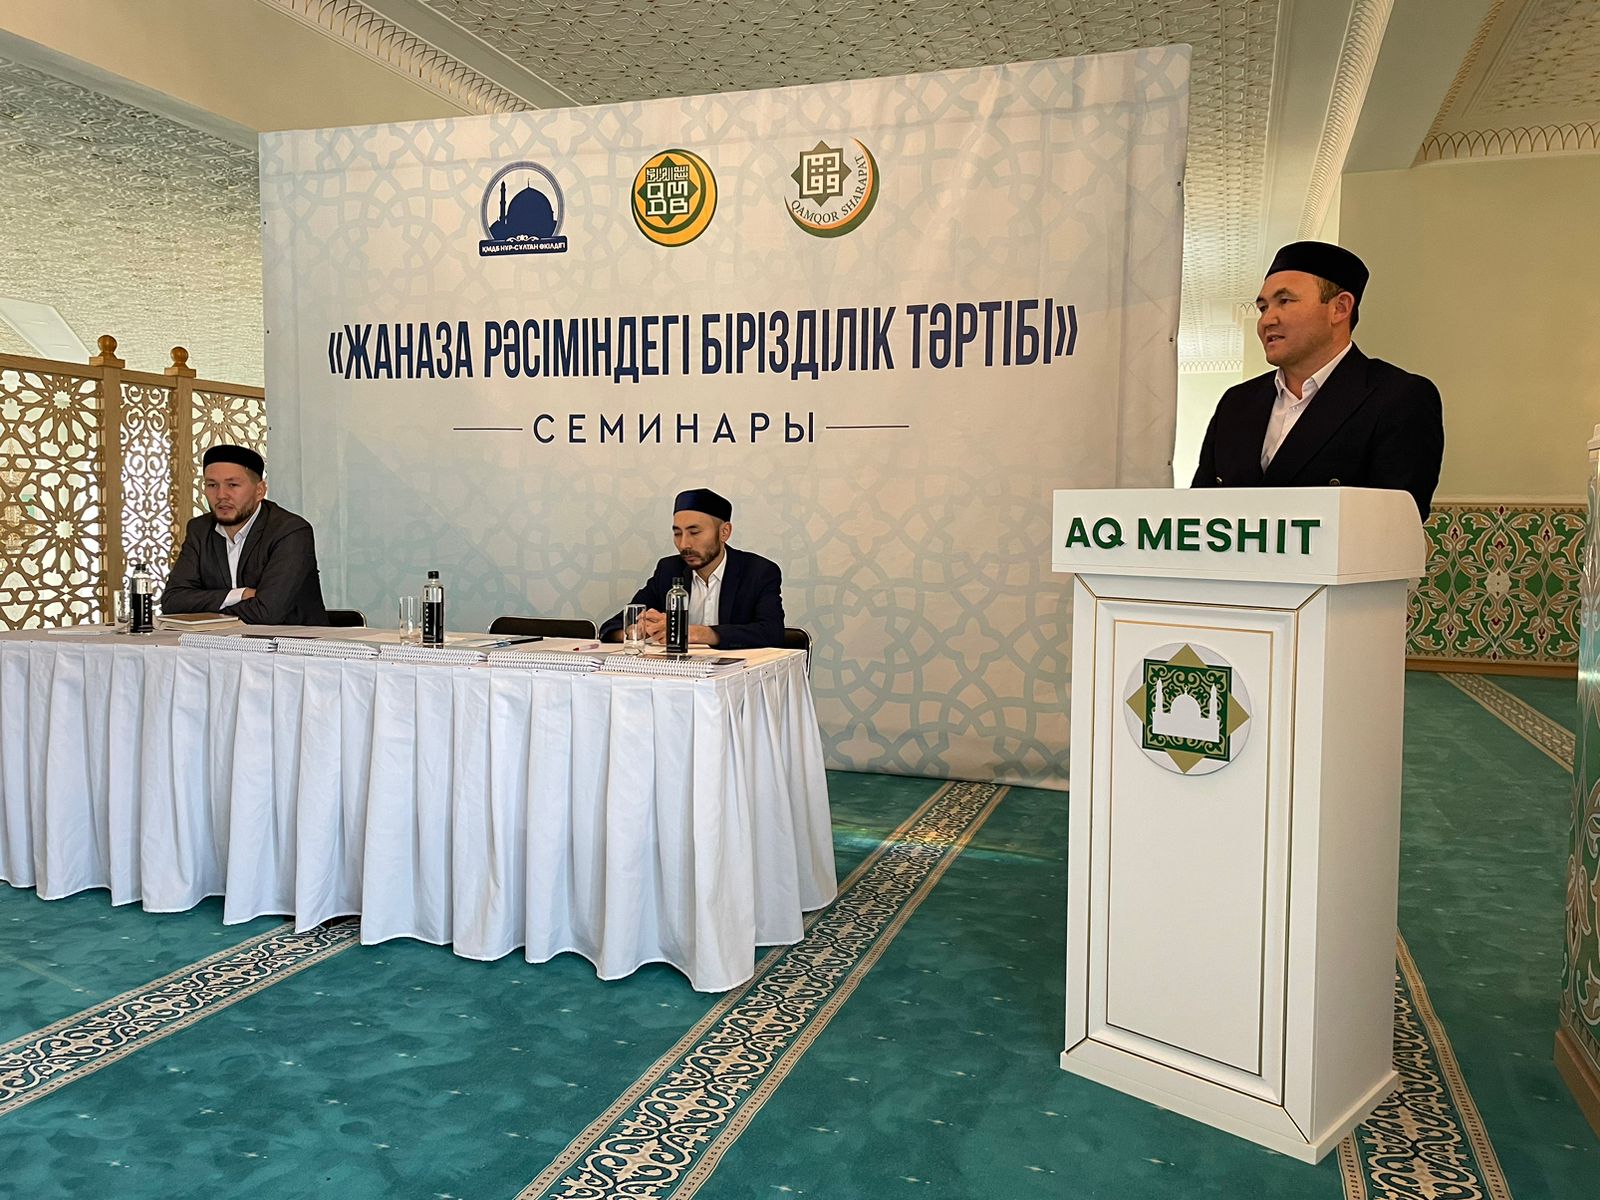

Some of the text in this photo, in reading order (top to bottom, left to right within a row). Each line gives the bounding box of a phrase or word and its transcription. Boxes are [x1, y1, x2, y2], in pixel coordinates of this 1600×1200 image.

[791, 199, 840, 225] QAMQOR
[841, 154, 867, 216] SHARAPAT
[328, 298, 1078, 384] «ЖАНАЗА РӘСІМІНДЕГІ БІРІЗДІЛІК ТӘРТІБІ»
[532, 412, 814, 444] СЕМИНАРЫ
[1065, 517, 1321, 555] AQ MESHIT
